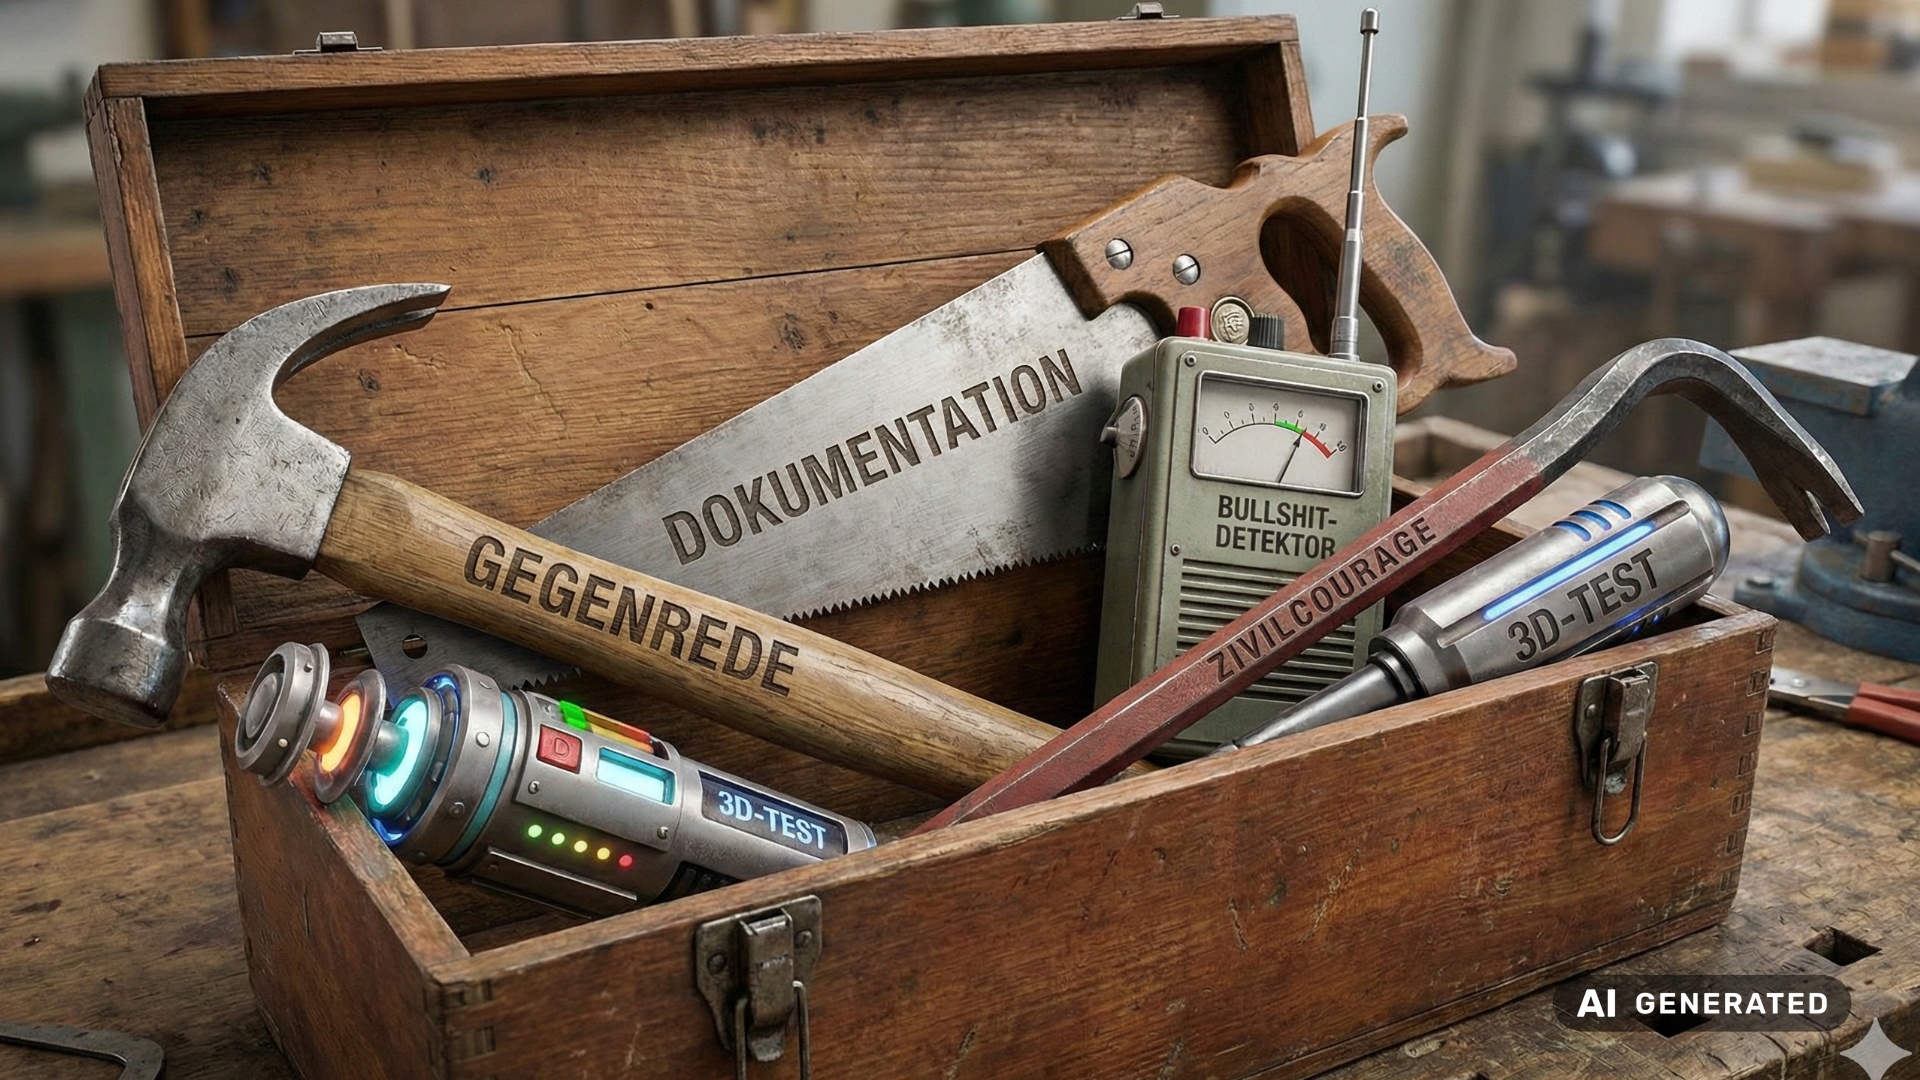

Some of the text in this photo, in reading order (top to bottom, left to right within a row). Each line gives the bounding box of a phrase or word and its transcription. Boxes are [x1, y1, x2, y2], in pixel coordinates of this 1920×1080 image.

[661, 348, 1083, 566] DOKUMENTATION
[1215, 524, 1336, 559] DETEKTOR
[1217, 495, 1338, 529] BULLSHIT-
[463, 535, 799, 697] GEGENREDE
[1206, 517, 1437, 684] ZIVILCOURAGE
[1507, 547, 1658, 662] 3D-TEST
[553, 736, 571, 759] D
[718, 790, 827, 850] 3D-TEST
